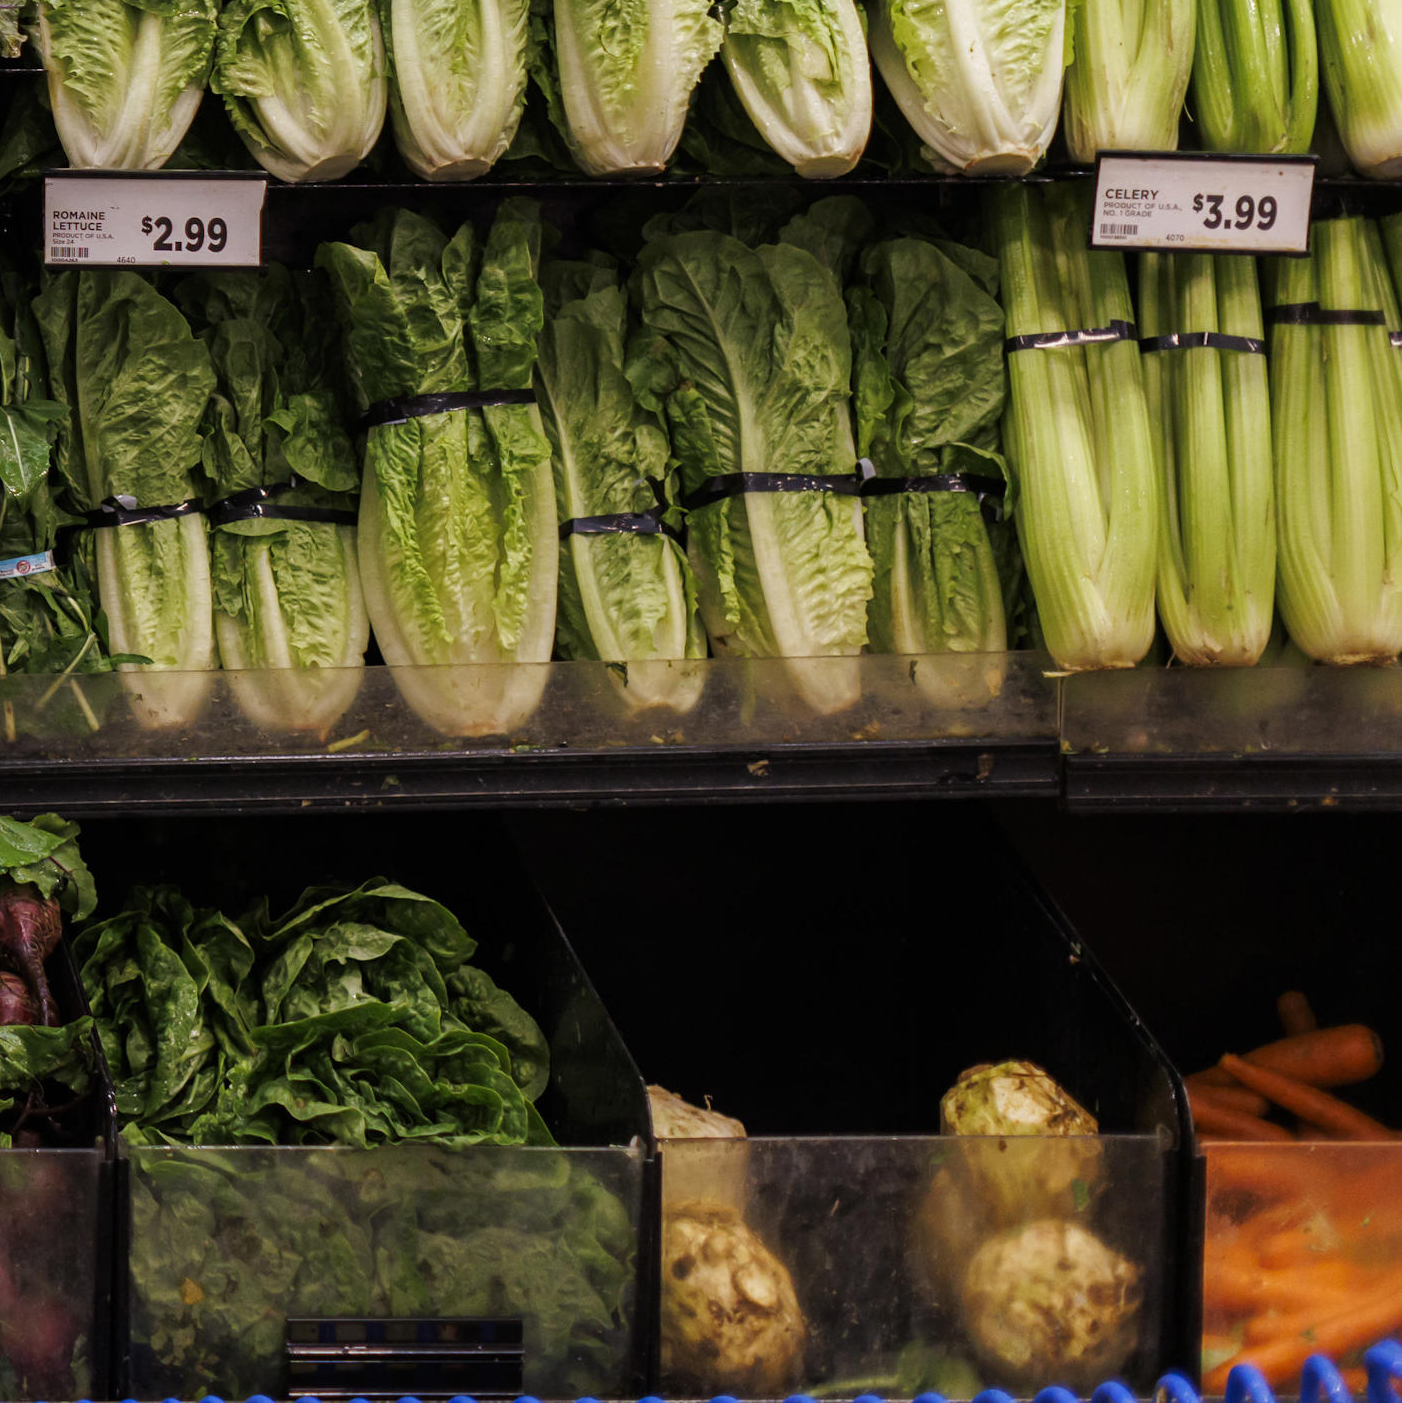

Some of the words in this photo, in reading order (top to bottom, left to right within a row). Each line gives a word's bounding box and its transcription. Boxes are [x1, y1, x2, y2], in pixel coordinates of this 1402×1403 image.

[1105, 189, 1159, 200] CELERY
[53, 211, 105, 220] ROMAINE
[1192, 193, 1277, 231] $3.99
[53, 222, 102, 231] LETTUCE
[141, 215, 227, 253] $2.99
[116, 256, 136, 264] 4640
